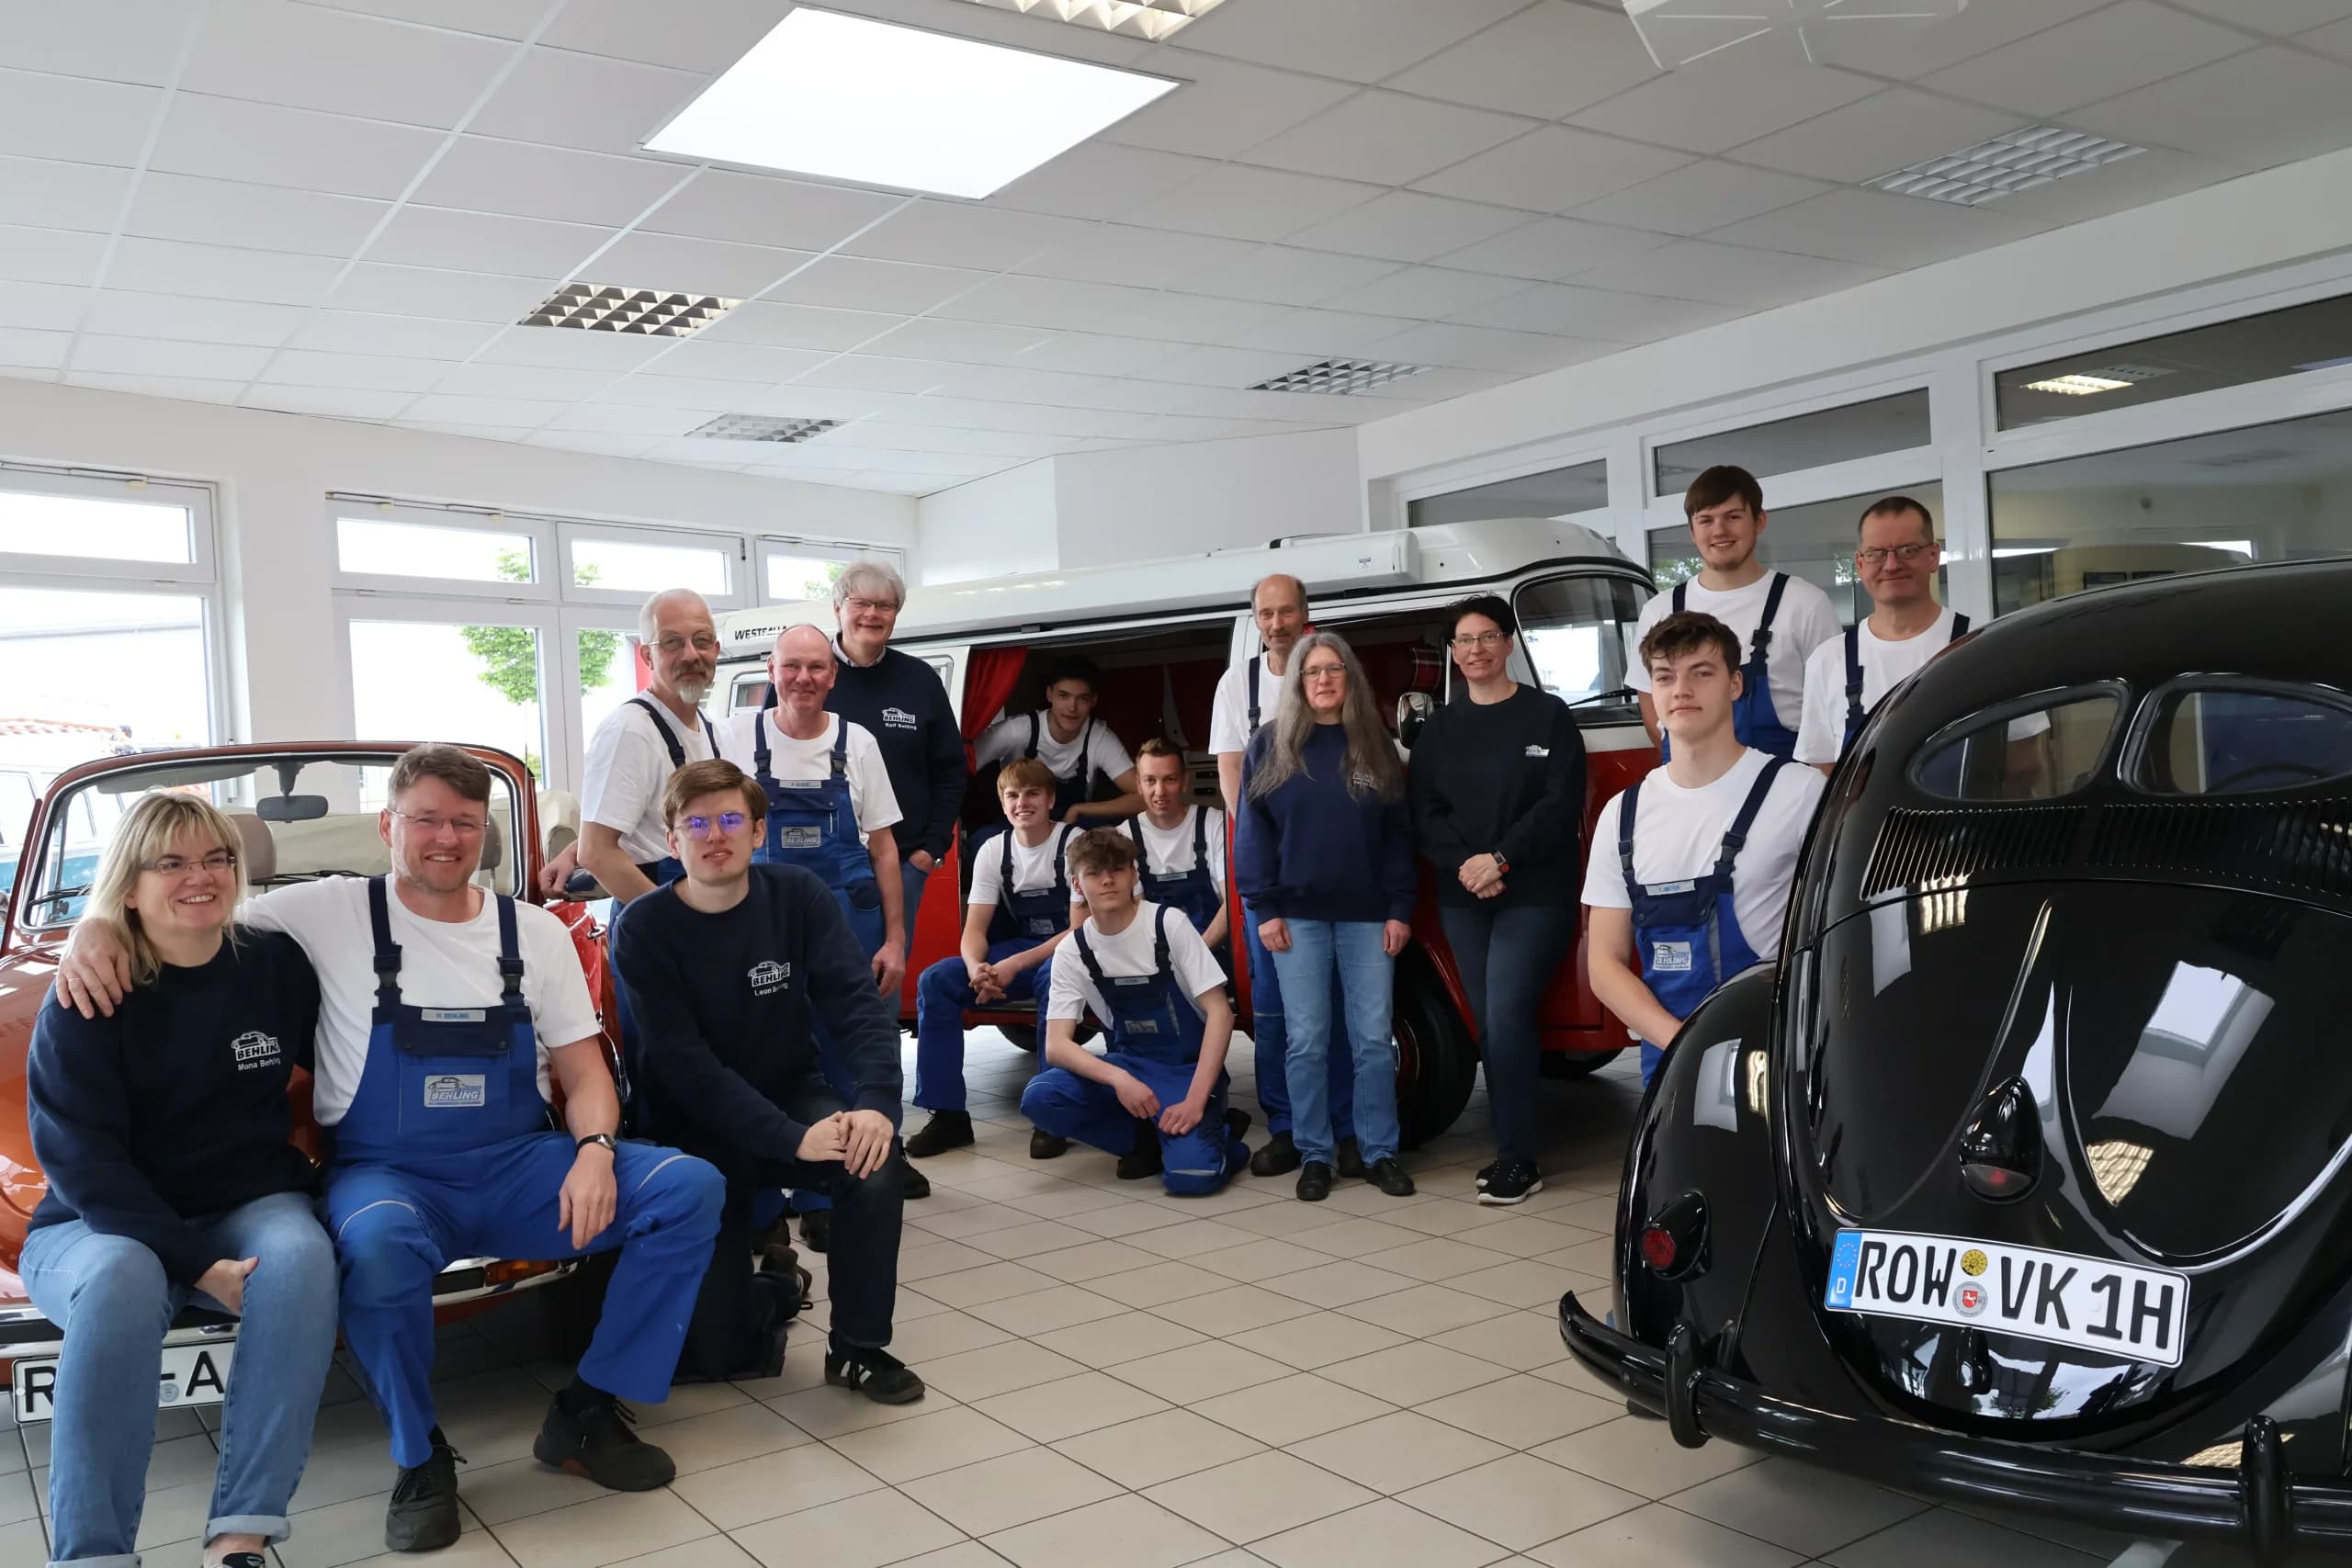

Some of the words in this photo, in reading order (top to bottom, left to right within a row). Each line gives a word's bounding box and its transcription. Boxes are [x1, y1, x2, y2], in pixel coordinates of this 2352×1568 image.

[753, 988, 772, 997] Leon
[237, 1062, 258, 1071] Mona
[431, 1090, 480, 1100] BEHLING
[1836, 1278, 1846, 1294] D
[1854, 1240, 1957, 1307] ROW
[2000, 1256, 2079, 1331] VK
[2086, 1274, 2175, 1350] 1H
